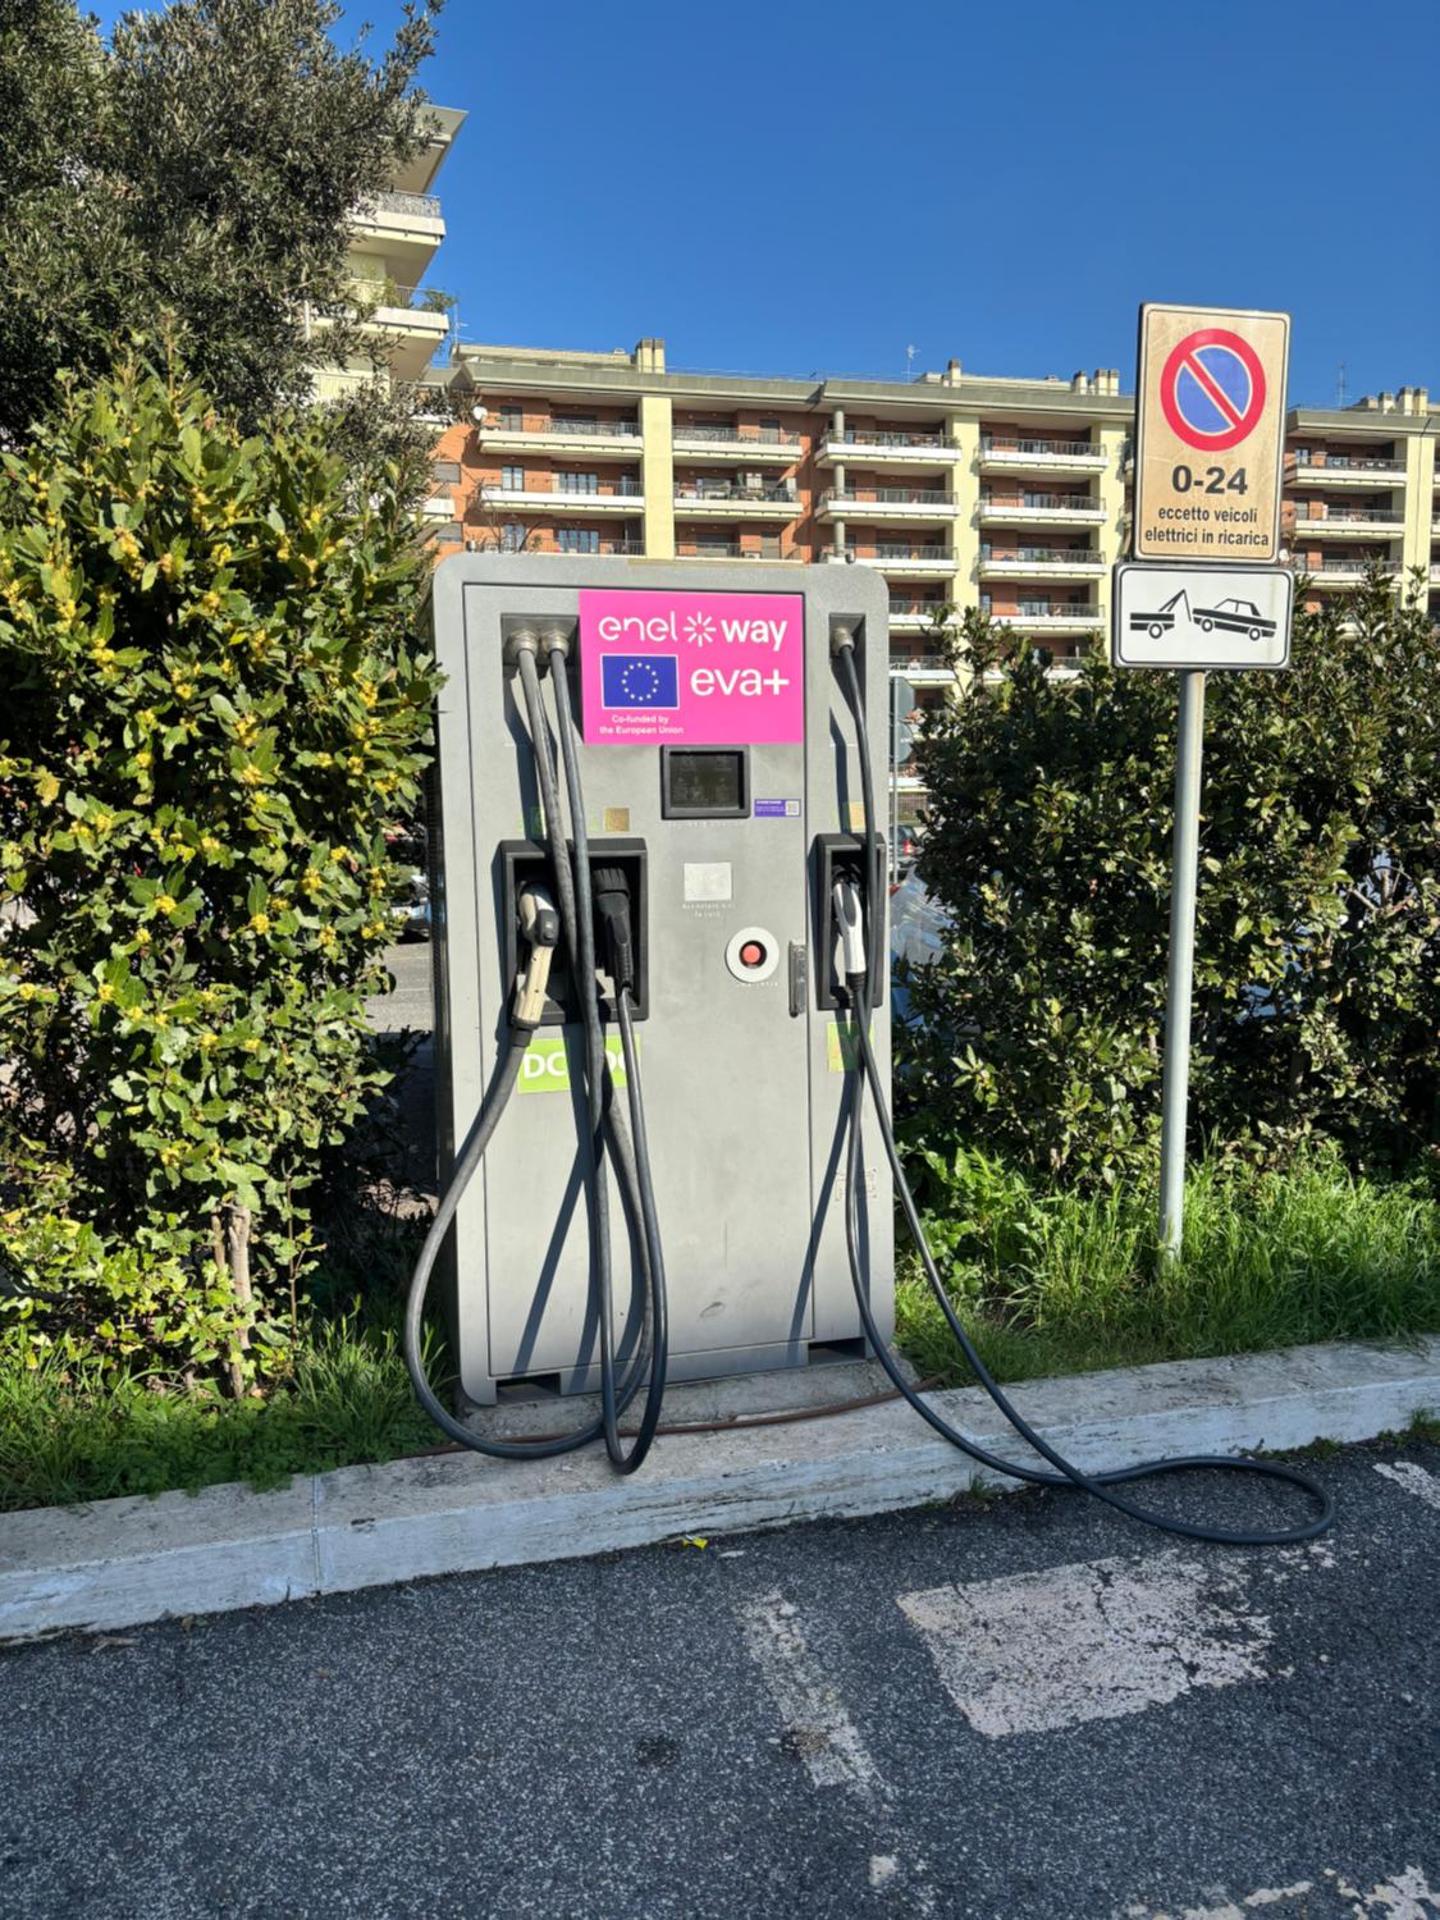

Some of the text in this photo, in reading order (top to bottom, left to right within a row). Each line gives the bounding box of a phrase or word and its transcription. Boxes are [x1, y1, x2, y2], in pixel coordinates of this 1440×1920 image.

[1172, 465, 1248, 495] 0-24
[1158, 506, 1258, 522] eccetto veicoli
[1145, 526, 1269, 545] elettrici in ricarica
[598, 611, 788, 652] enel way
[690, 668, 789, 696] eva+
[611, 714, 669, 725] Co-funded by
[599, 725, 684, 736] the European Union
